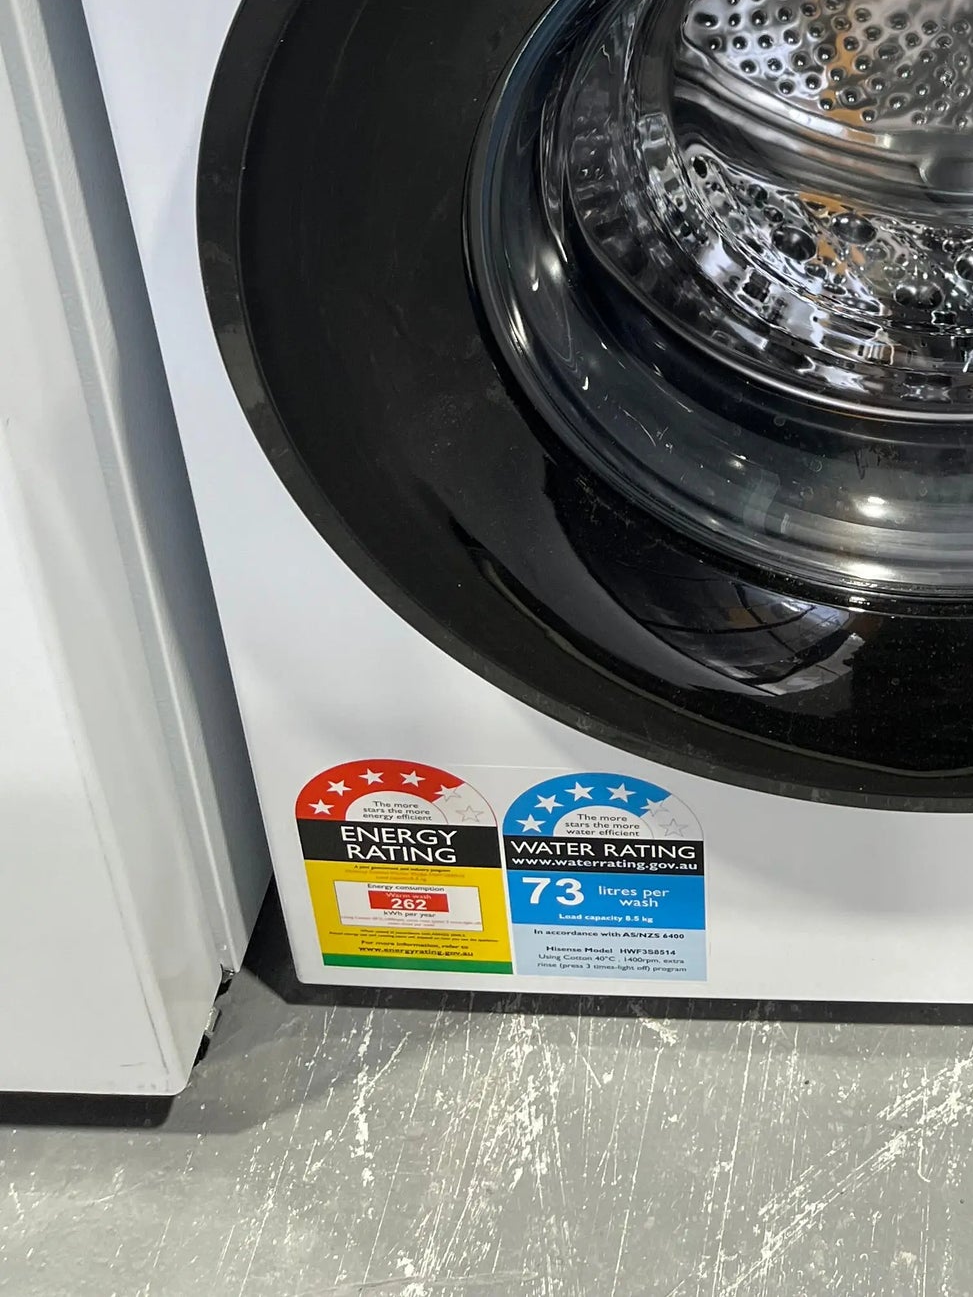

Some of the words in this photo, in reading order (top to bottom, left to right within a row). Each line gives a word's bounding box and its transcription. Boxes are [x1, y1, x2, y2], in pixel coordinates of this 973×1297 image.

[372, 800, 397, 808] The
[363, 813, 393, 821] energy
[593, 821, 610, 829] the
[340, 825, 458, 846] ENERGY
[599, 829, 640, 837] efficient
[346, 844, 457, 864] RATING
[510, 840, 596, 856] WATER
[603, 843, 696, 859] RATING
[512, 857, 698, 871] www.waterrating.gov.au
[395, 884, 445, 892] consumption
[522, 876, 585, 907] 73
[598, 885, 637, 896] litres
[643, 889, 669, 899] per
[391, 898, 428, 911] 262
[619, 897, 659, 908] wash
[584, 914, 623, 923] capacity
[641, 916, 654, 924] kg
[538, 954, 561, 962] Using
[563, 954, 593, 962] Cotton
[559, 963, 584, 971] (press
